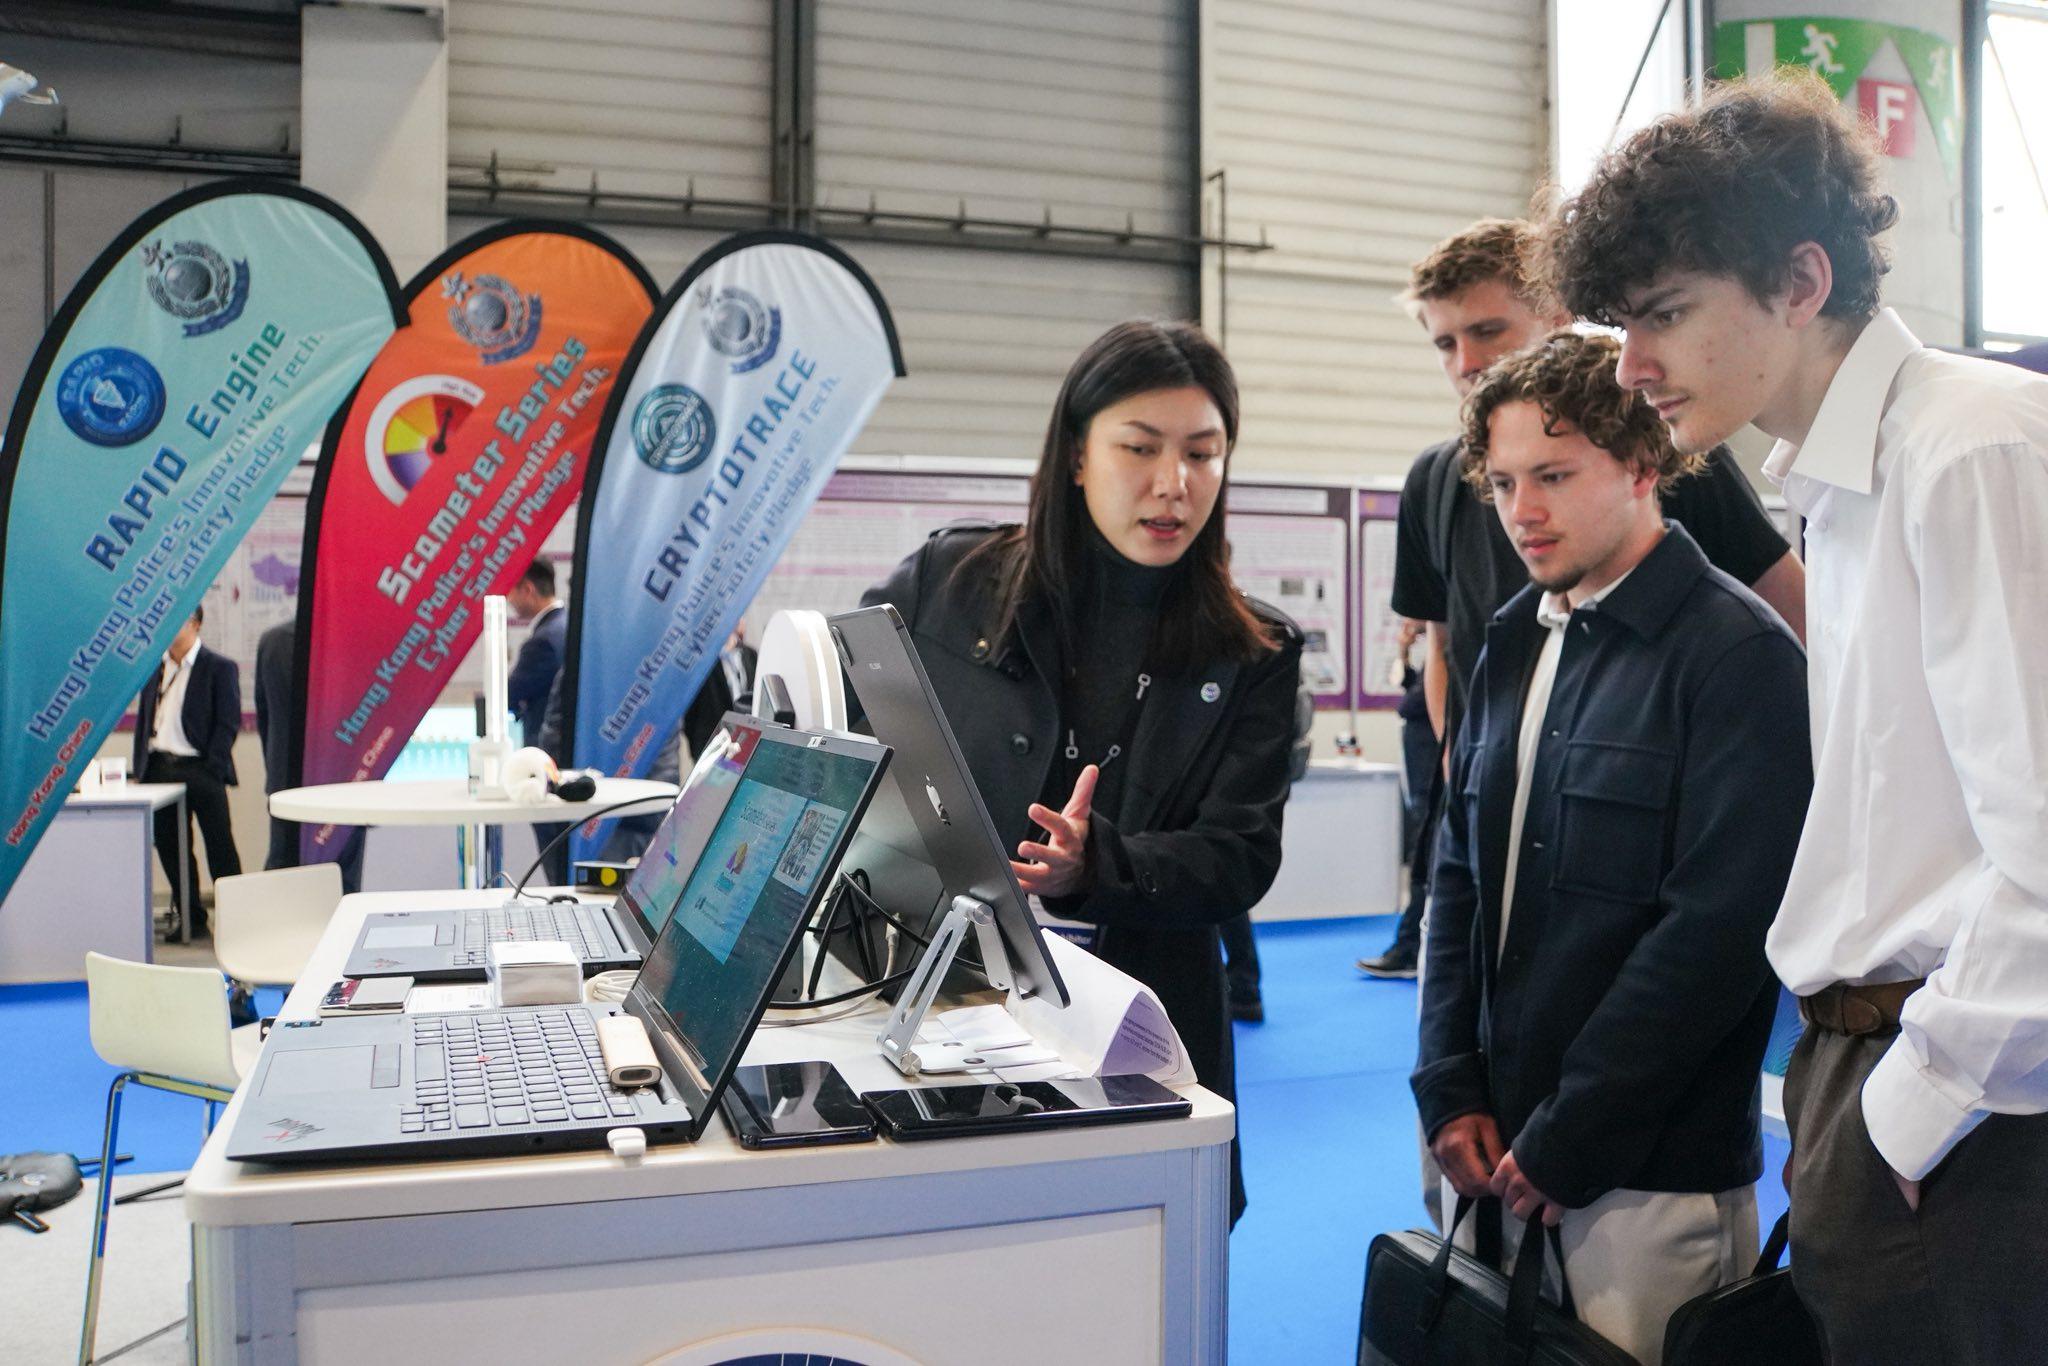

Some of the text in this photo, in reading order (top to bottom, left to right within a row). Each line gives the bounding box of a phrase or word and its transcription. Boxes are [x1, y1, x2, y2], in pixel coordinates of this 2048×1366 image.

[1876, 85, 1908, 138] F
[62, 354, 105, 399] RAPID
[85, 446, 188, 571] RAPID
[186, 321, 286, 439] Engine
[377, 439, 505, 605] Scameter
[496, 337, 587, 443] Series
[644, 348, 816, 602] CRYPTOTRACE
[28, 669, 88, 739] Hong
[74, 608, 131, 675] Kong
[115, 515, 191, 612] Police's
[182, 390, 274, 518] Innovative
[271, 333, 324, 390] Tech.
[117, 587, 178, 664] Cyber
[168, 501, 234, 586] Safety
[226, 424, 289, 503] Pledge
[335, 685, 390, 745] Hong
[376, 620, 430, 681] Kong
[416, 533, 486, 623] Police's
[478, 421, 566, 534] Innovative
[557, 366, 610, 419] Tech.
[415, 451, 577, 672] Cyber Safety Pledge
[602, 682, 649, 741] Hong
[640, 619, 686, 680] Kong
[680, 539, 735, 621] Police's
[729, 425, 800, 537] Innovative
[800, 375, 840, 424] Tech.
[674, 456, 814, 671] Cyber Safety Pledge
[7, 808, 39, 847] Hong
[58, 720, 93, 762] China
